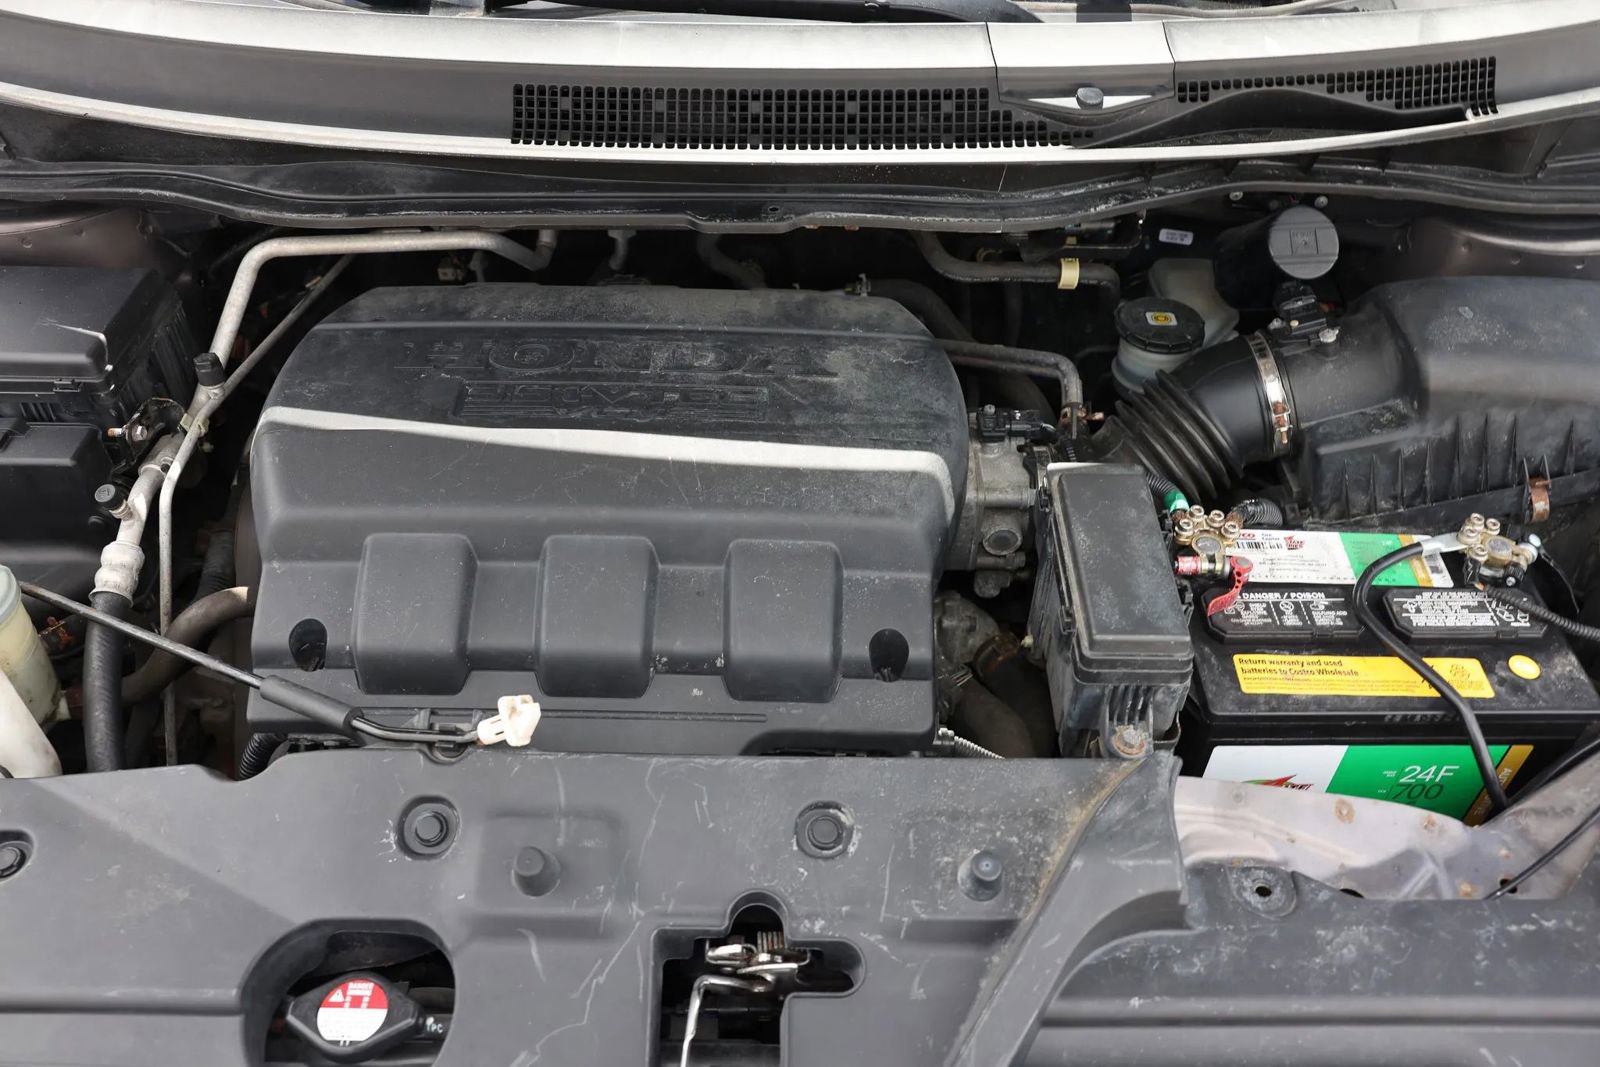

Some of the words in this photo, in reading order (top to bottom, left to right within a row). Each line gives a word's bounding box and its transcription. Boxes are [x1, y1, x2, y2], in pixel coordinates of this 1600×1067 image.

[1290, 592, 1326, 600] POISON
[1269, 659, 1305, 668] warranty
[1324, 659, 1343, 667] used
[1241, 667, 1277, 675] batteries
[1316, 669, 1360, 677] Wholesale
[1399, 765, 1460, 783] 24F
[1391, 783, 1445, 801] 700
